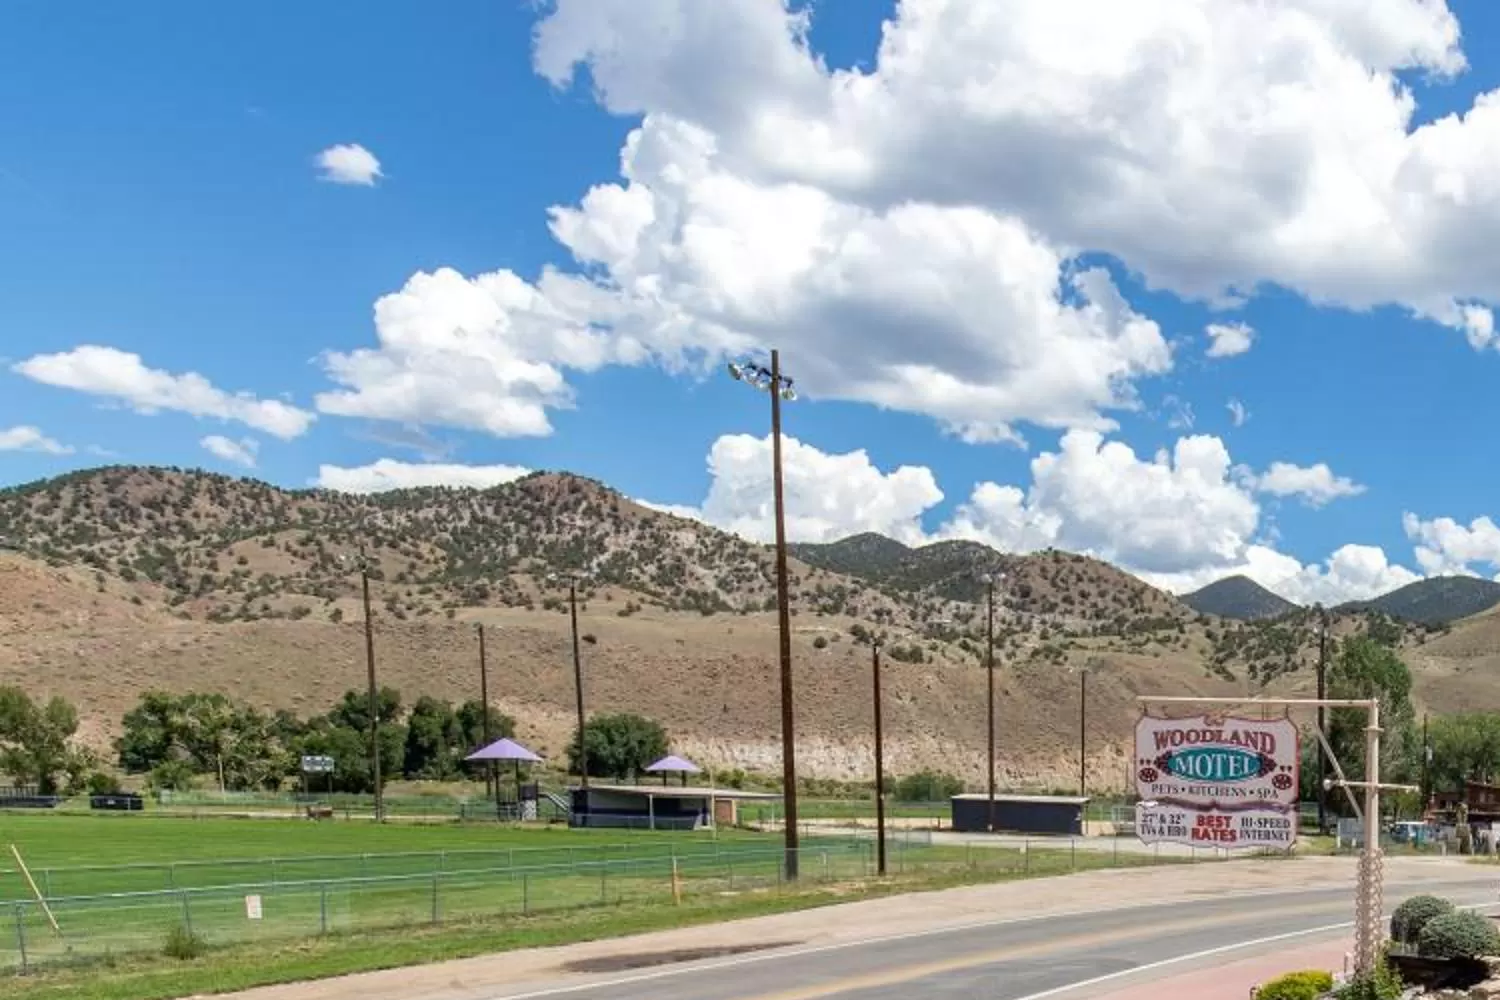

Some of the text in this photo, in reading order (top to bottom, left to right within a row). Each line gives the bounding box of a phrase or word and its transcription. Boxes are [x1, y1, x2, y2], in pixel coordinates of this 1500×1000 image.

[1153, 729, 1276, 755] WOODLAND
[1175, 753, 1255, 778] MOTEL
[1151, 784, 1179, 794] PETS
[1257, 789, 1279, 799] SPA
[1196, 815, 1232, 828] BEST
[1241, 817, 1291, 829] HI-SPEED
[1191, 827, 1236, 842] RATES
[1240, 829, 1290, 841] INTERNET
